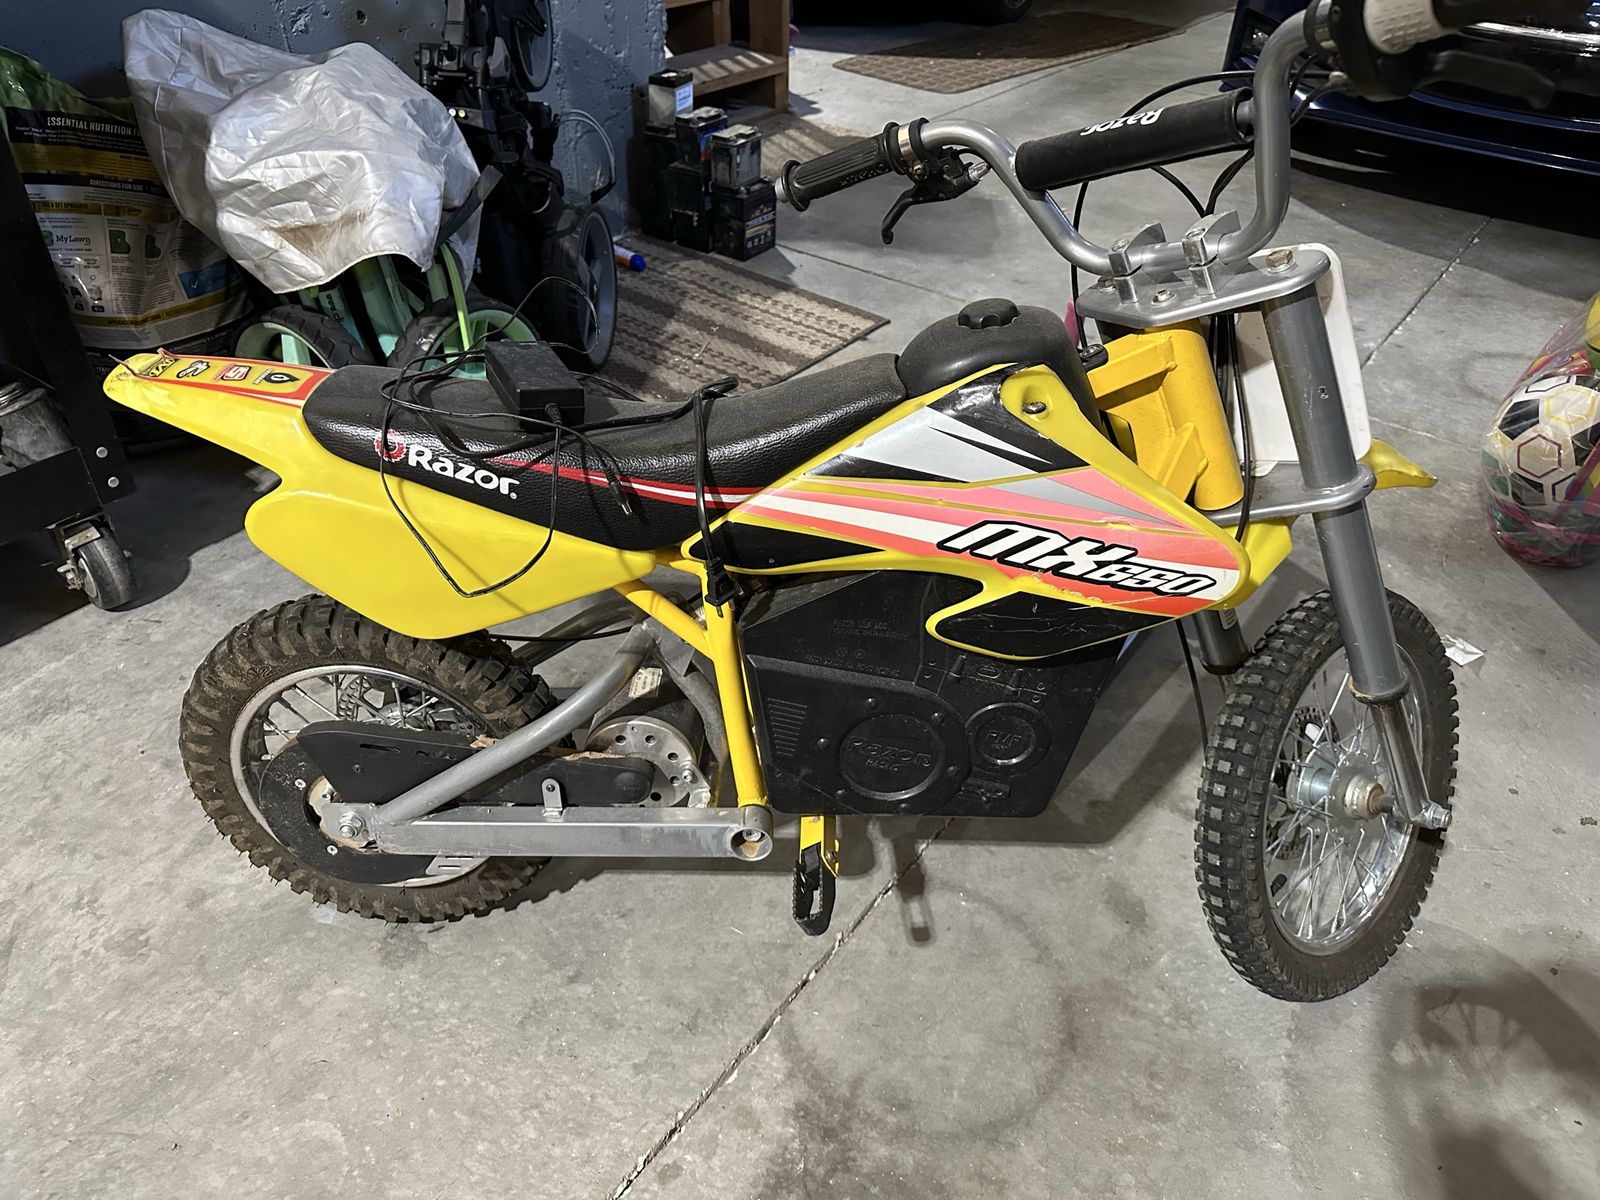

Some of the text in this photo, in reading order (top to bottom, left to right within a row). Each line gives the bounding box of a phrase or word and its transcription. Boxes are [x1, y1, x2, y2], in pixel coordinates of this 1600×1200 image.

[47, 117, 88, 130] ESSENTIAL
[90, 122, 132, 136] NUTRITION
[1080, 107, 1165, 136] Razor
[89, 178, 121, 190] DIRECTIONS
[121, 181, 133, 191] FOR
[407, 444, 520, 496] Razor
[937, 520, 1217, 596] MX650
